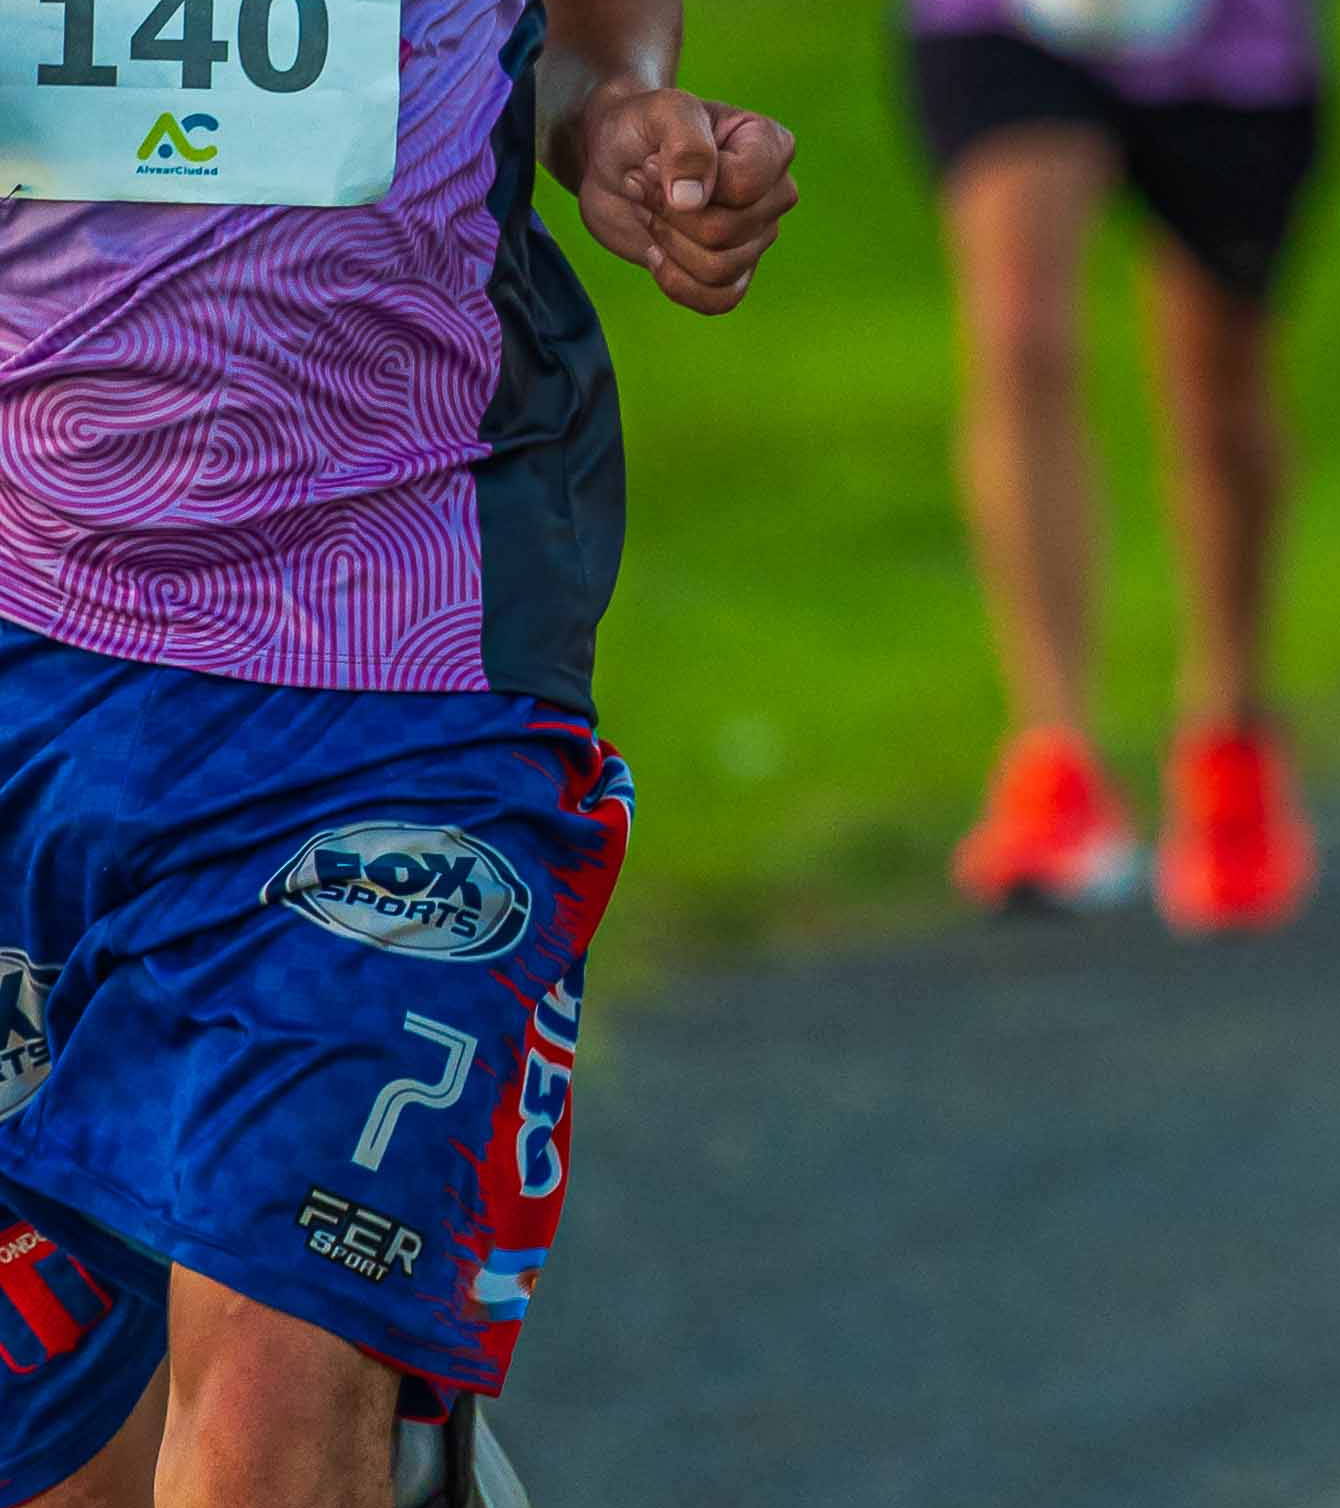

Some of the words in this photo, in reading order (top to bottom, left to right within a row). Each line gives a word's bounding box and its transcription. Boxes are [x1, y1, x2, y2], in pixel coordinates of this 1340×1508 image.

[313, 850, 484, 911] FOX
[316, 884, 480, 939] SPORTS
[351, 1010, 479, 1172] 7
[309, 1229, 389, 1281] SPORT
